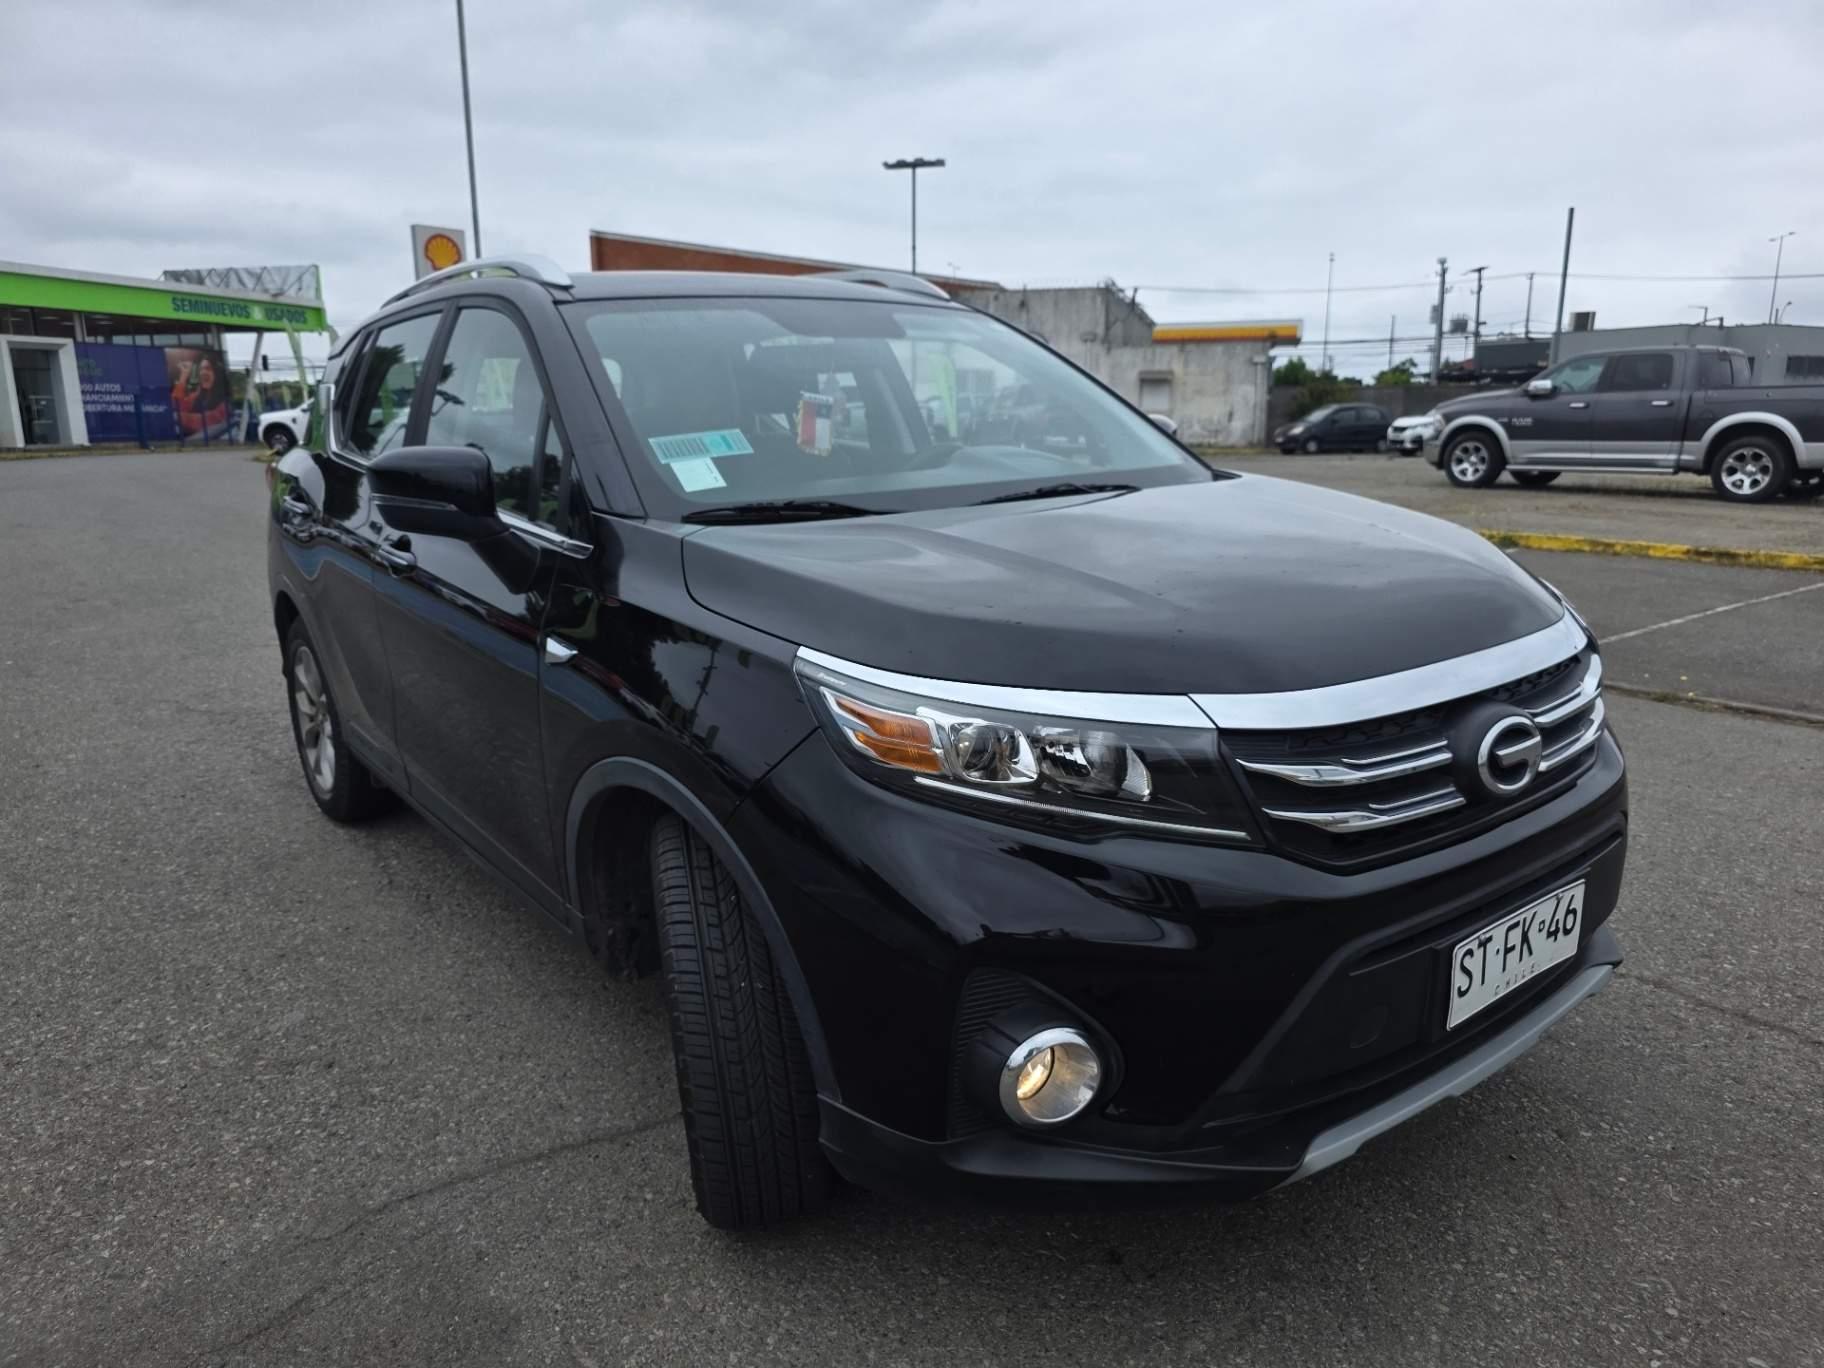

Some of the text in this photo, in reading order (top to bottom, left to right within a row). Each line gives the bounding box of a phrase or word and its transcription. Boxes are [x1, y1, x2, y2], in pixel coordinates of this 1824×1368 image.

[171, 297, 250, 319] SEMINUEVOS
[264, 306, 307, 324] USADOS
[94, 383, 121, 392] AUTOS
